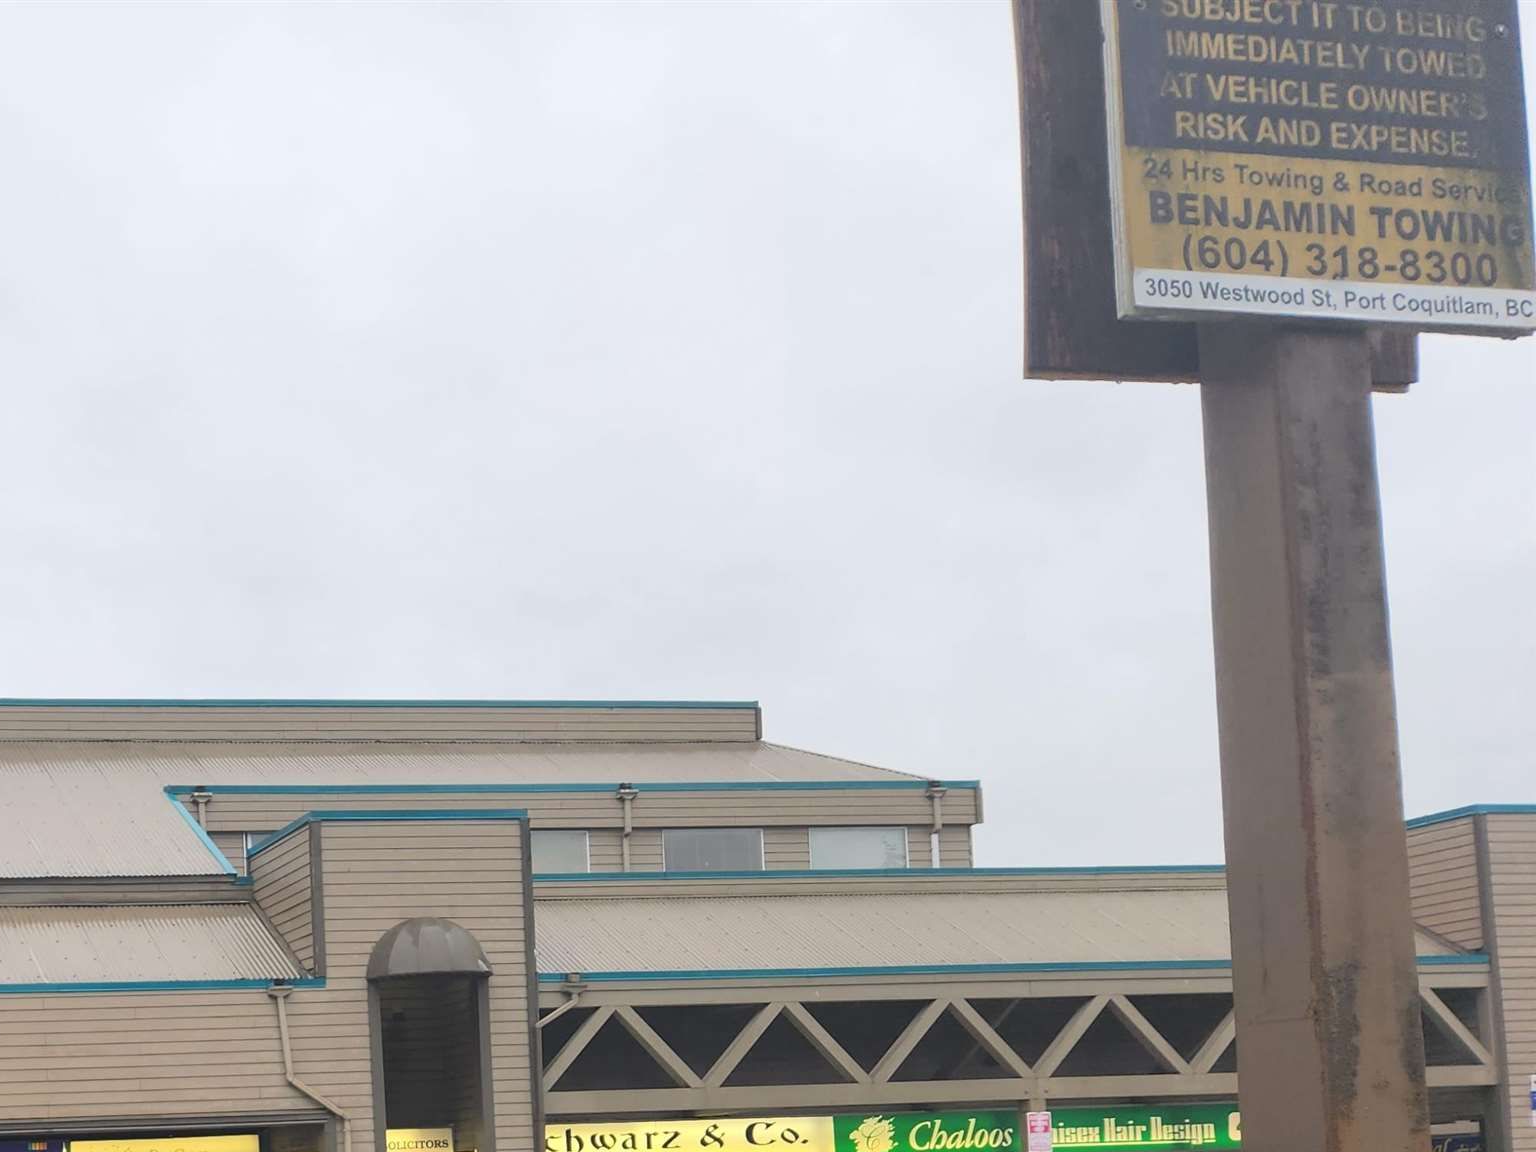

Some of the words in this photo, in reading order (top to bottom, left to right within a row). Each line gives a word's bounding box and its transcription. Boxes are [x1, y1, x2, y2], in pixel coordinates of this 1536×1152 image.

[1161, 0, 1302, 25] SUBJECT
[1312, 1, 1336, 29] IT
[1349, 5, 1386, 33] TO
[1397, 9, 1487, 42] BEING
[1167, 29, 1369, 70] IMMEDIATELY
[1379, 46, 1486, 80] TOWED
[1160, 72, 1197, 99] AT
[1206, 73, 1339, 109] VEHICLE
[1347, 84, 1488, 120] OWNER'S
[1175, 110, 1249, 142] RISK
[1256, 116, 1321, 147] AND
[1143, 158, 1173, 180] 24
[1182, 160, 1224, 183] Hrs
[1234, 164, 1323, 196] Towing
[1333, 172, 1350, 191] &
[1360, 173, 1422, 196] Road
[1149, 190, 1355, 235] BENJAMIN
[1369, 206, 1525, 247] TOWING
[1183, 233, 1288, 277] (604)
[1305, 242, 1497, 287] 318-8300
[1145, 278, 1193, 299] 3050
[1200, 281, 1304, 305] Westwood
[1312, 288, 1337, 310] St,
[1345, 291, 1386, 311] Port
[1393, 293, 1499, 318] Coquitlam,
[1506, 299, 1534, 318] BC
[700, 1123, 725, 1149] &
[745, 1121, 809, 1147] Co.
[908, 1118, 1013, 1150] Chaloos
[1103, 1117, 1146, 1142] Hair
[1150, 1116, 1215, 1145] Design
